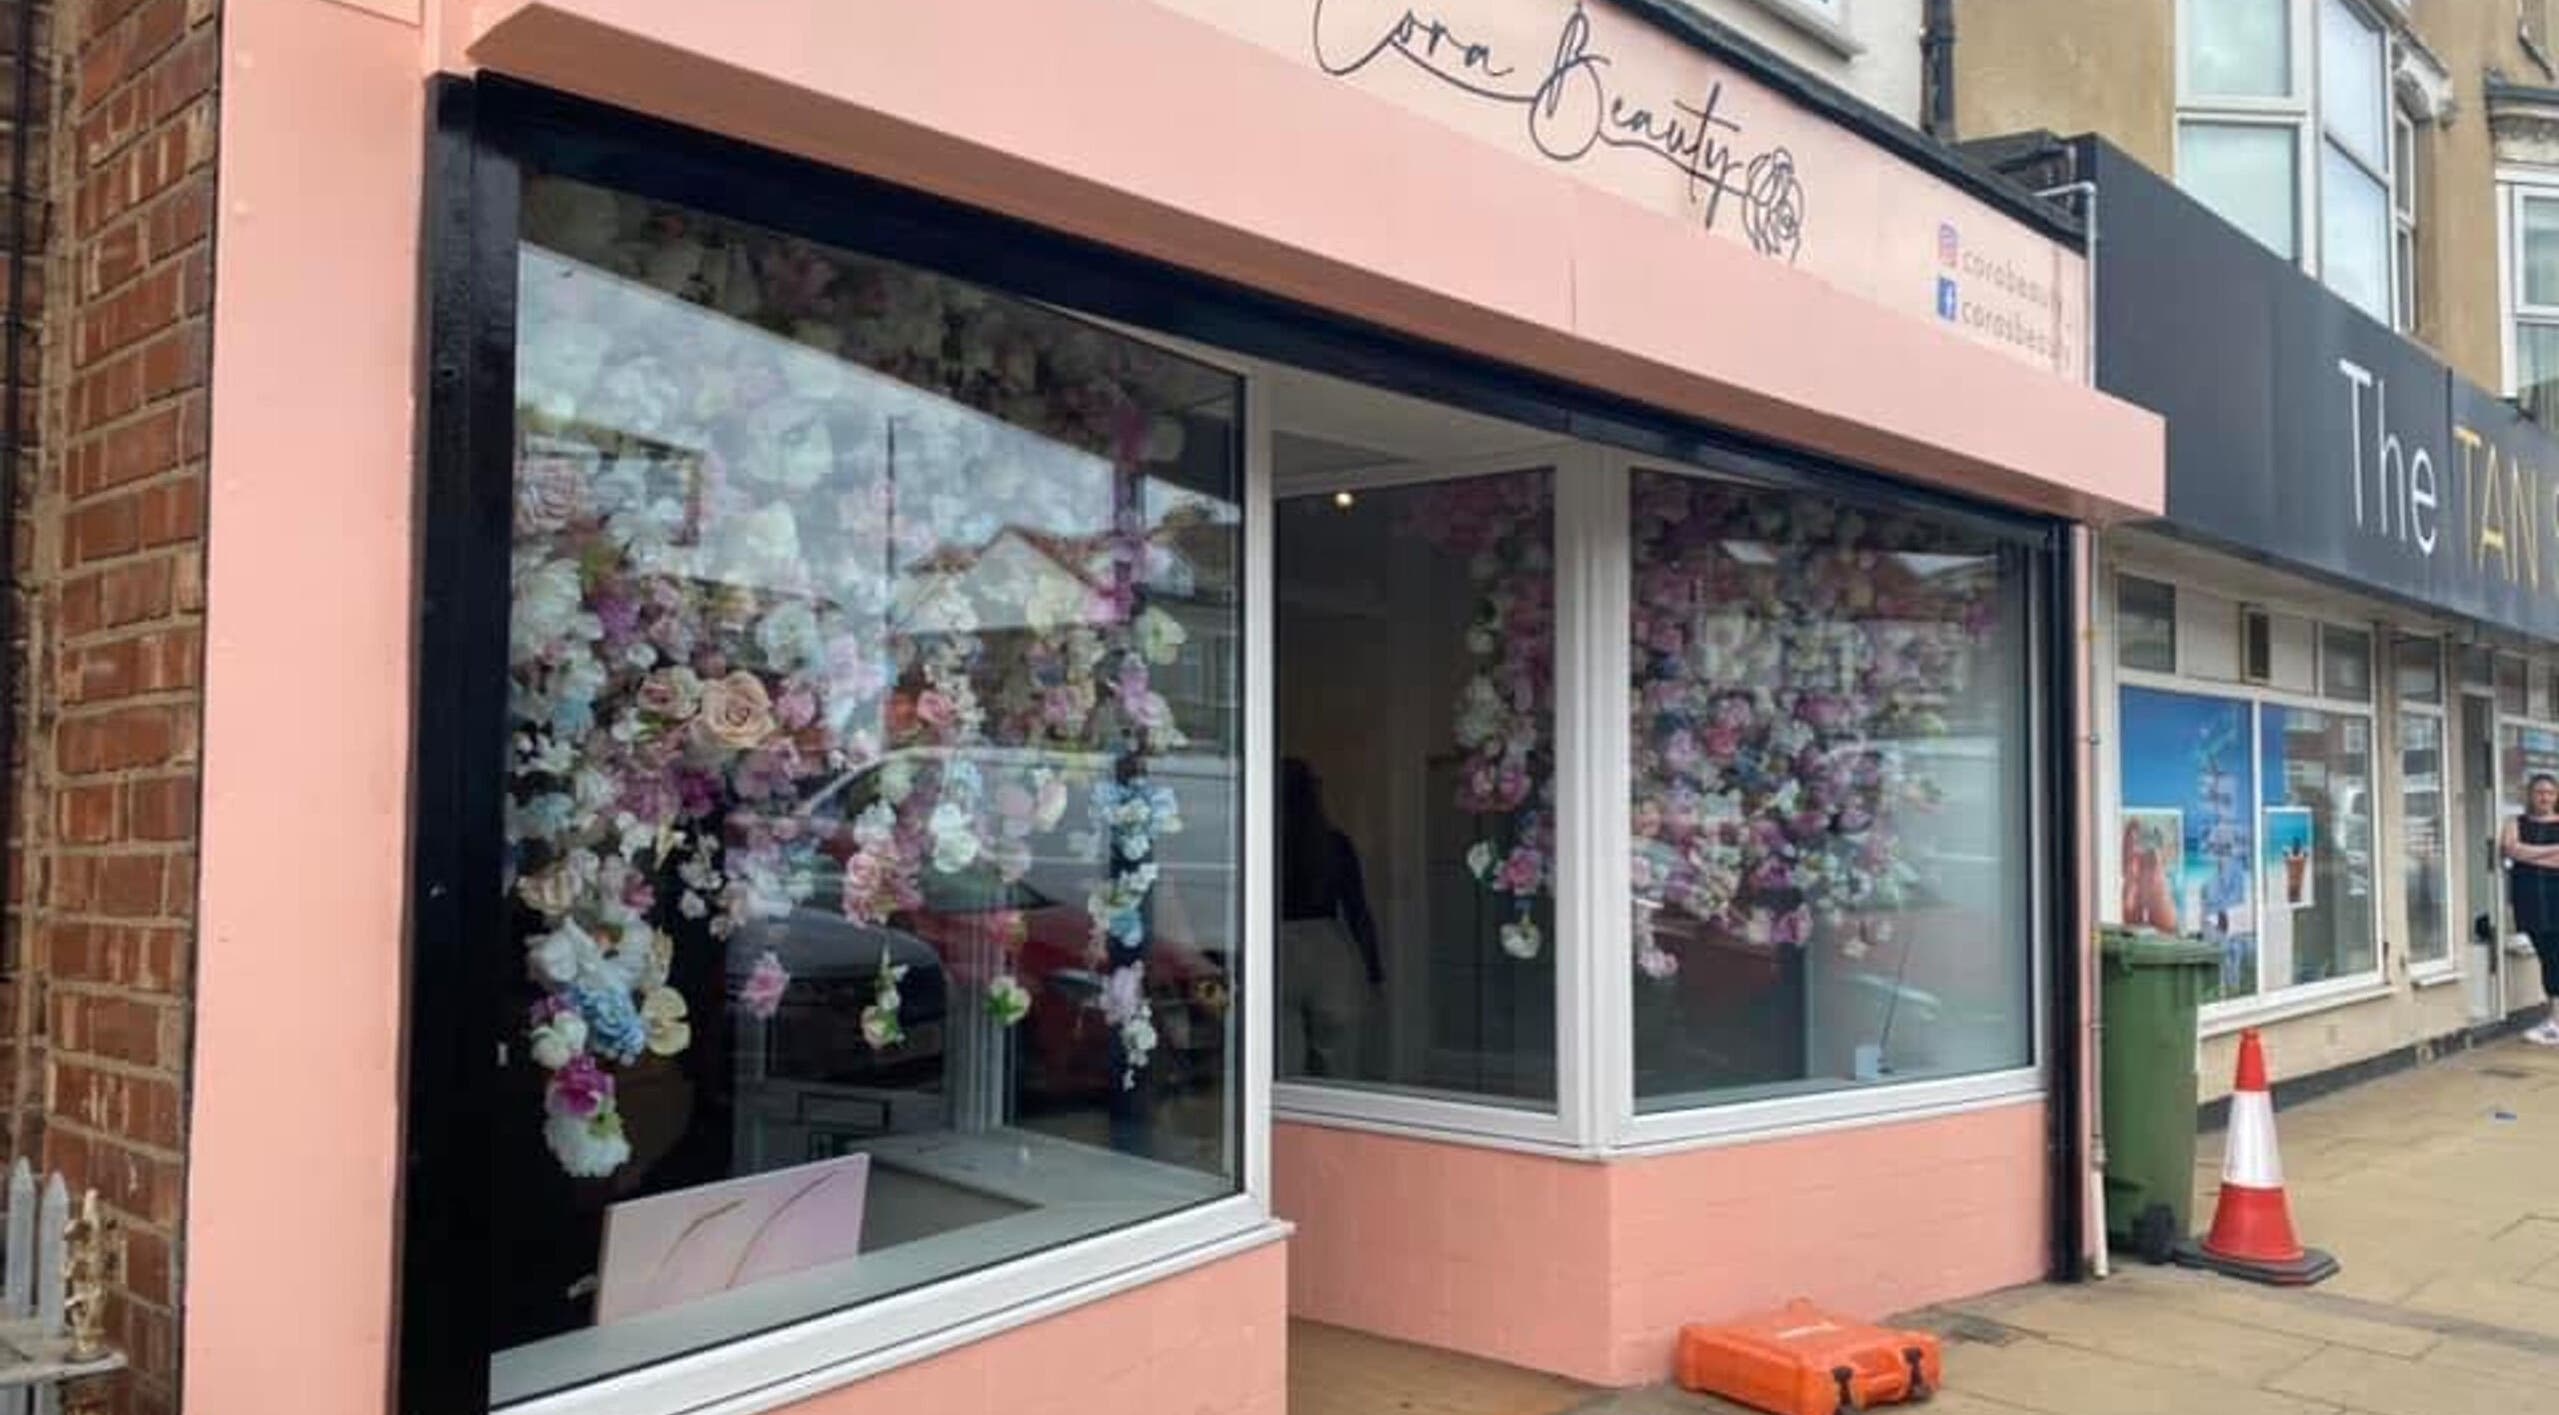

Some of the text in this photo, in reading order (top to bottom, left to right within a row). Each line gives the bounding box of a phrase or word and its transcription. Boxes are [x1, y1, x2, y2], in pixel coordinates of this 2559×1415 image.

[1528, 1, 1743, 230] Beauty
[2338, 358, 2438, 558] The
[2454, 424, 2539, 593] TAN
